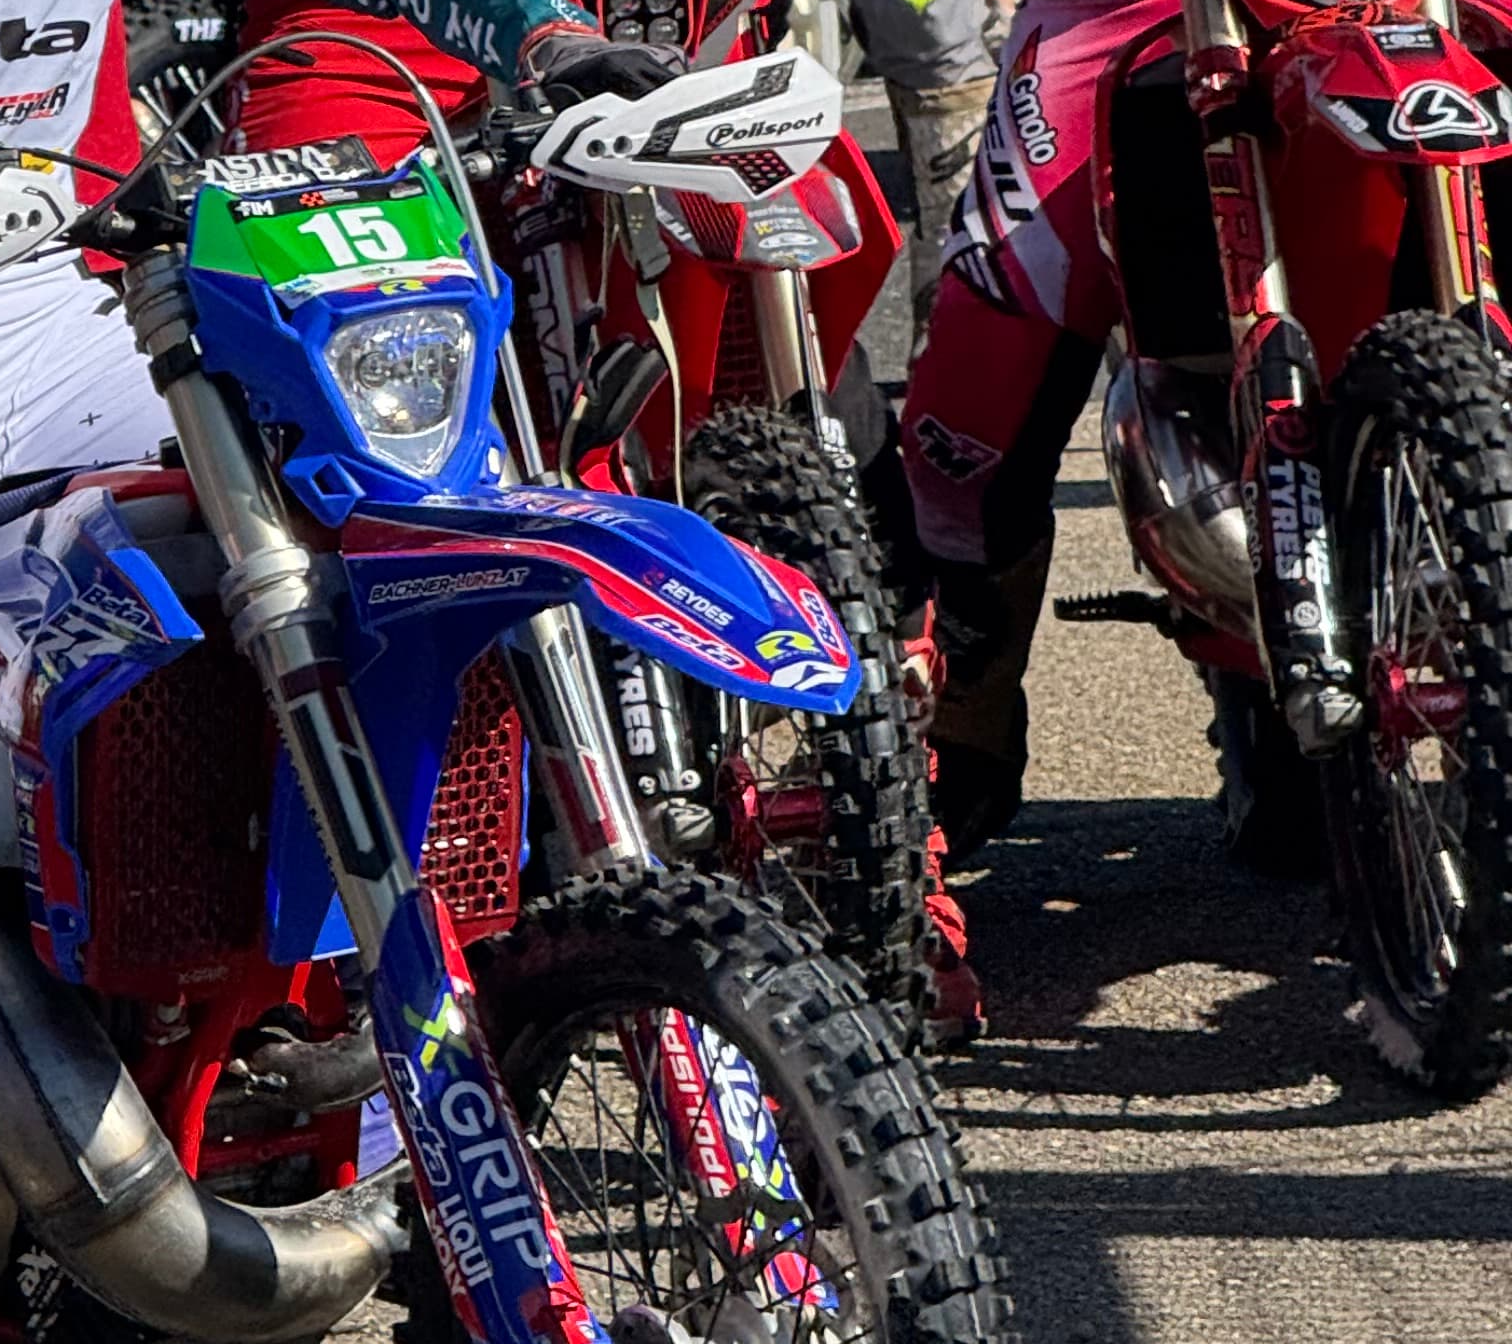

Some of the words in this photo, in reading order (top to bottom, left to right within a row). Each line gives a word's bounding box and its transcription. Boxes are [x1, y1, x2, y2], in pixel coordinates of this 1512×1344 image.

[705, 113, 826, 149] Polisport
[1009, 73, 1057, 165] Gmoto
[234, 198, 275, 217] FIM
[297, 208, 409, 269] 15
[1269, 458, 1301, 581] TYRES
[78, 582, 151, 629] Beta
[640, 616, 740, 668] Beta
[615, 651, 656, 757] YRES
[439, 1079, 549, 1273] GRIP
[433, 1192, 494, 1288] LIQUI
